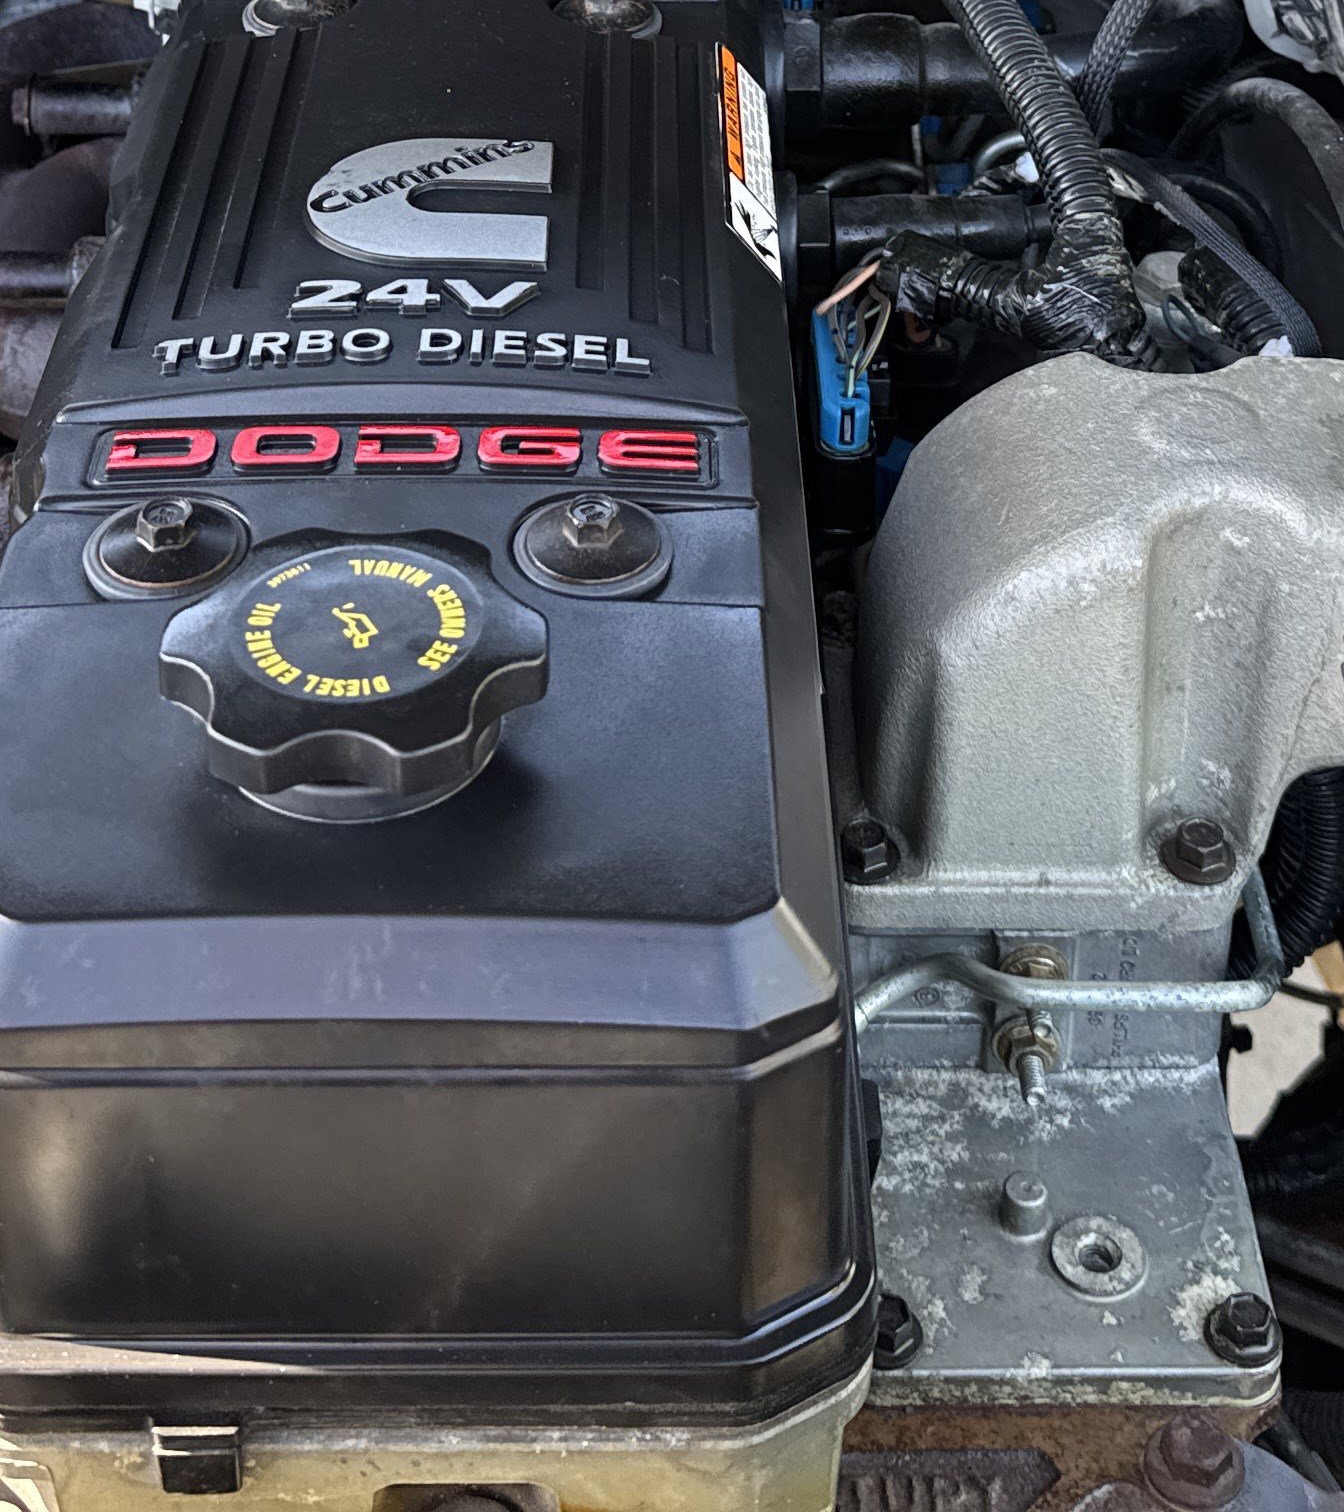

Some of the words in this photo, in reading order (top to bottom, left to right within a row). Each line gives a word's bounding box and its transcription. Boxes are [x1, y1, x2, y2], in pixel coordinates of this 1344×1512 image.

[722, 67, 739, 141] WARNING
[310, 139, 535, 213] Cummins
[287, 279, 540, 318] 24V
[153, 328, 392, 375] TURBO
[417, 328, 652, 374] DIESEL
[105, 425, 701, 475] DODGE
[349, 559, 433, 588] MANUAL
[247, 602, 281, 626] OIL
[245, 630, 302, 687] ENGINE
[417, 640, 458, 671] SEE
[302, 674, 391, 697] DIESEL
